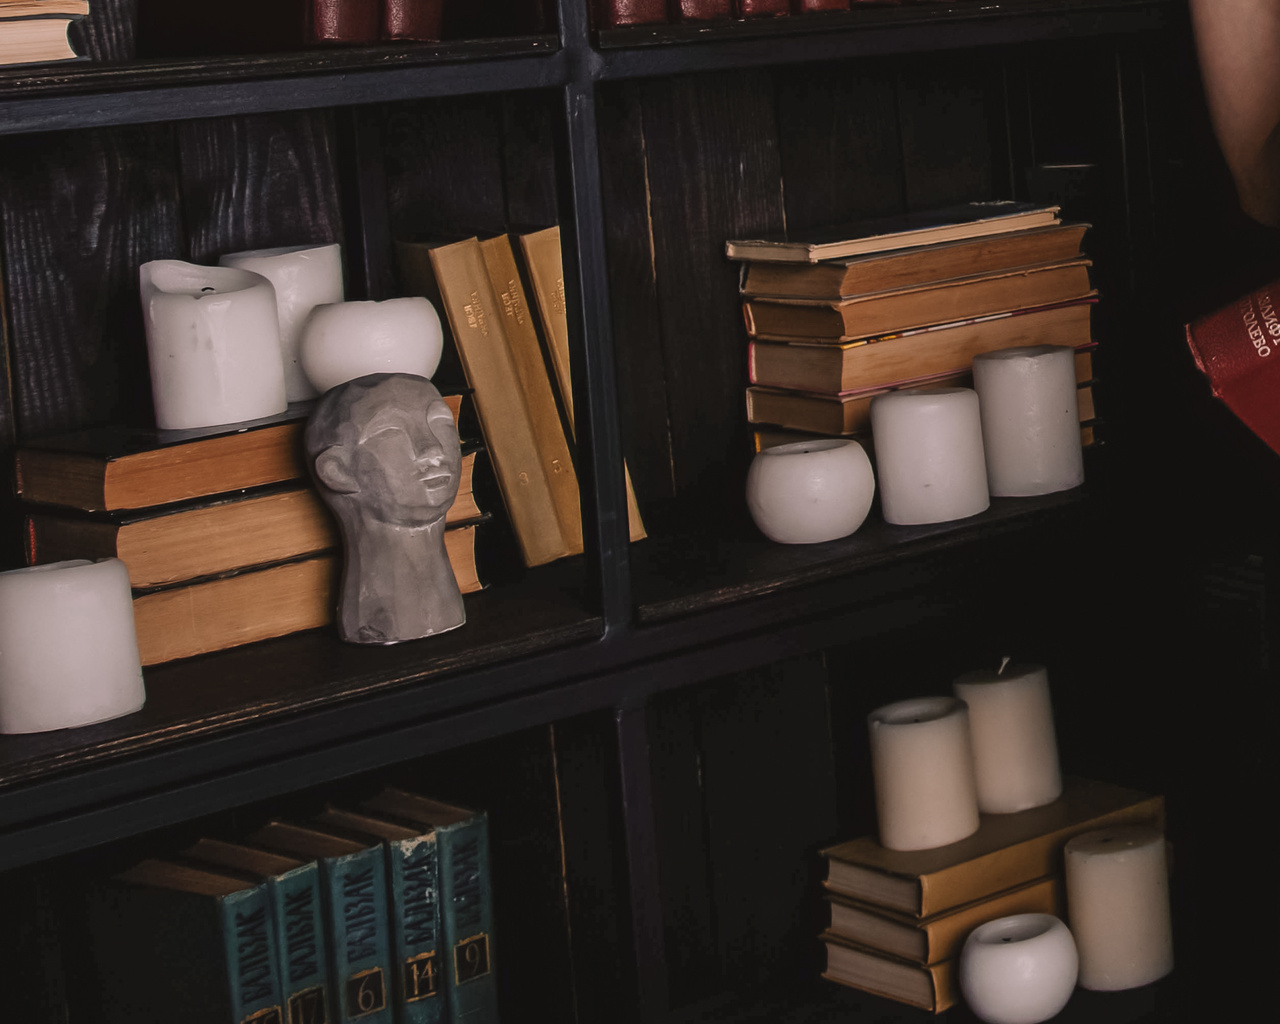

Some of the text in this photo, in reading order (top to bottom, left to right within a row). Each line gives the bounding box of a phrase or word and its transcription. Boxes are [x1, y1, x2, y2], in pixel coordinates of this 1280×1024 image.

[343, 867, 378, 963] БАЛЬЗАК
[403, 852, 434, 947] БАЛЬЗАК
[453, 837, 482, 927] БАЛЬЗАК
[236, 905, 273, 1006] БАЛЬЗАК
[285, 886, 319, 984] БАЛЬЗАК
[409, 960, 434, 996] 14
[464, 944, 481, 975] 9
[356, 976, 374, 1013] 6
